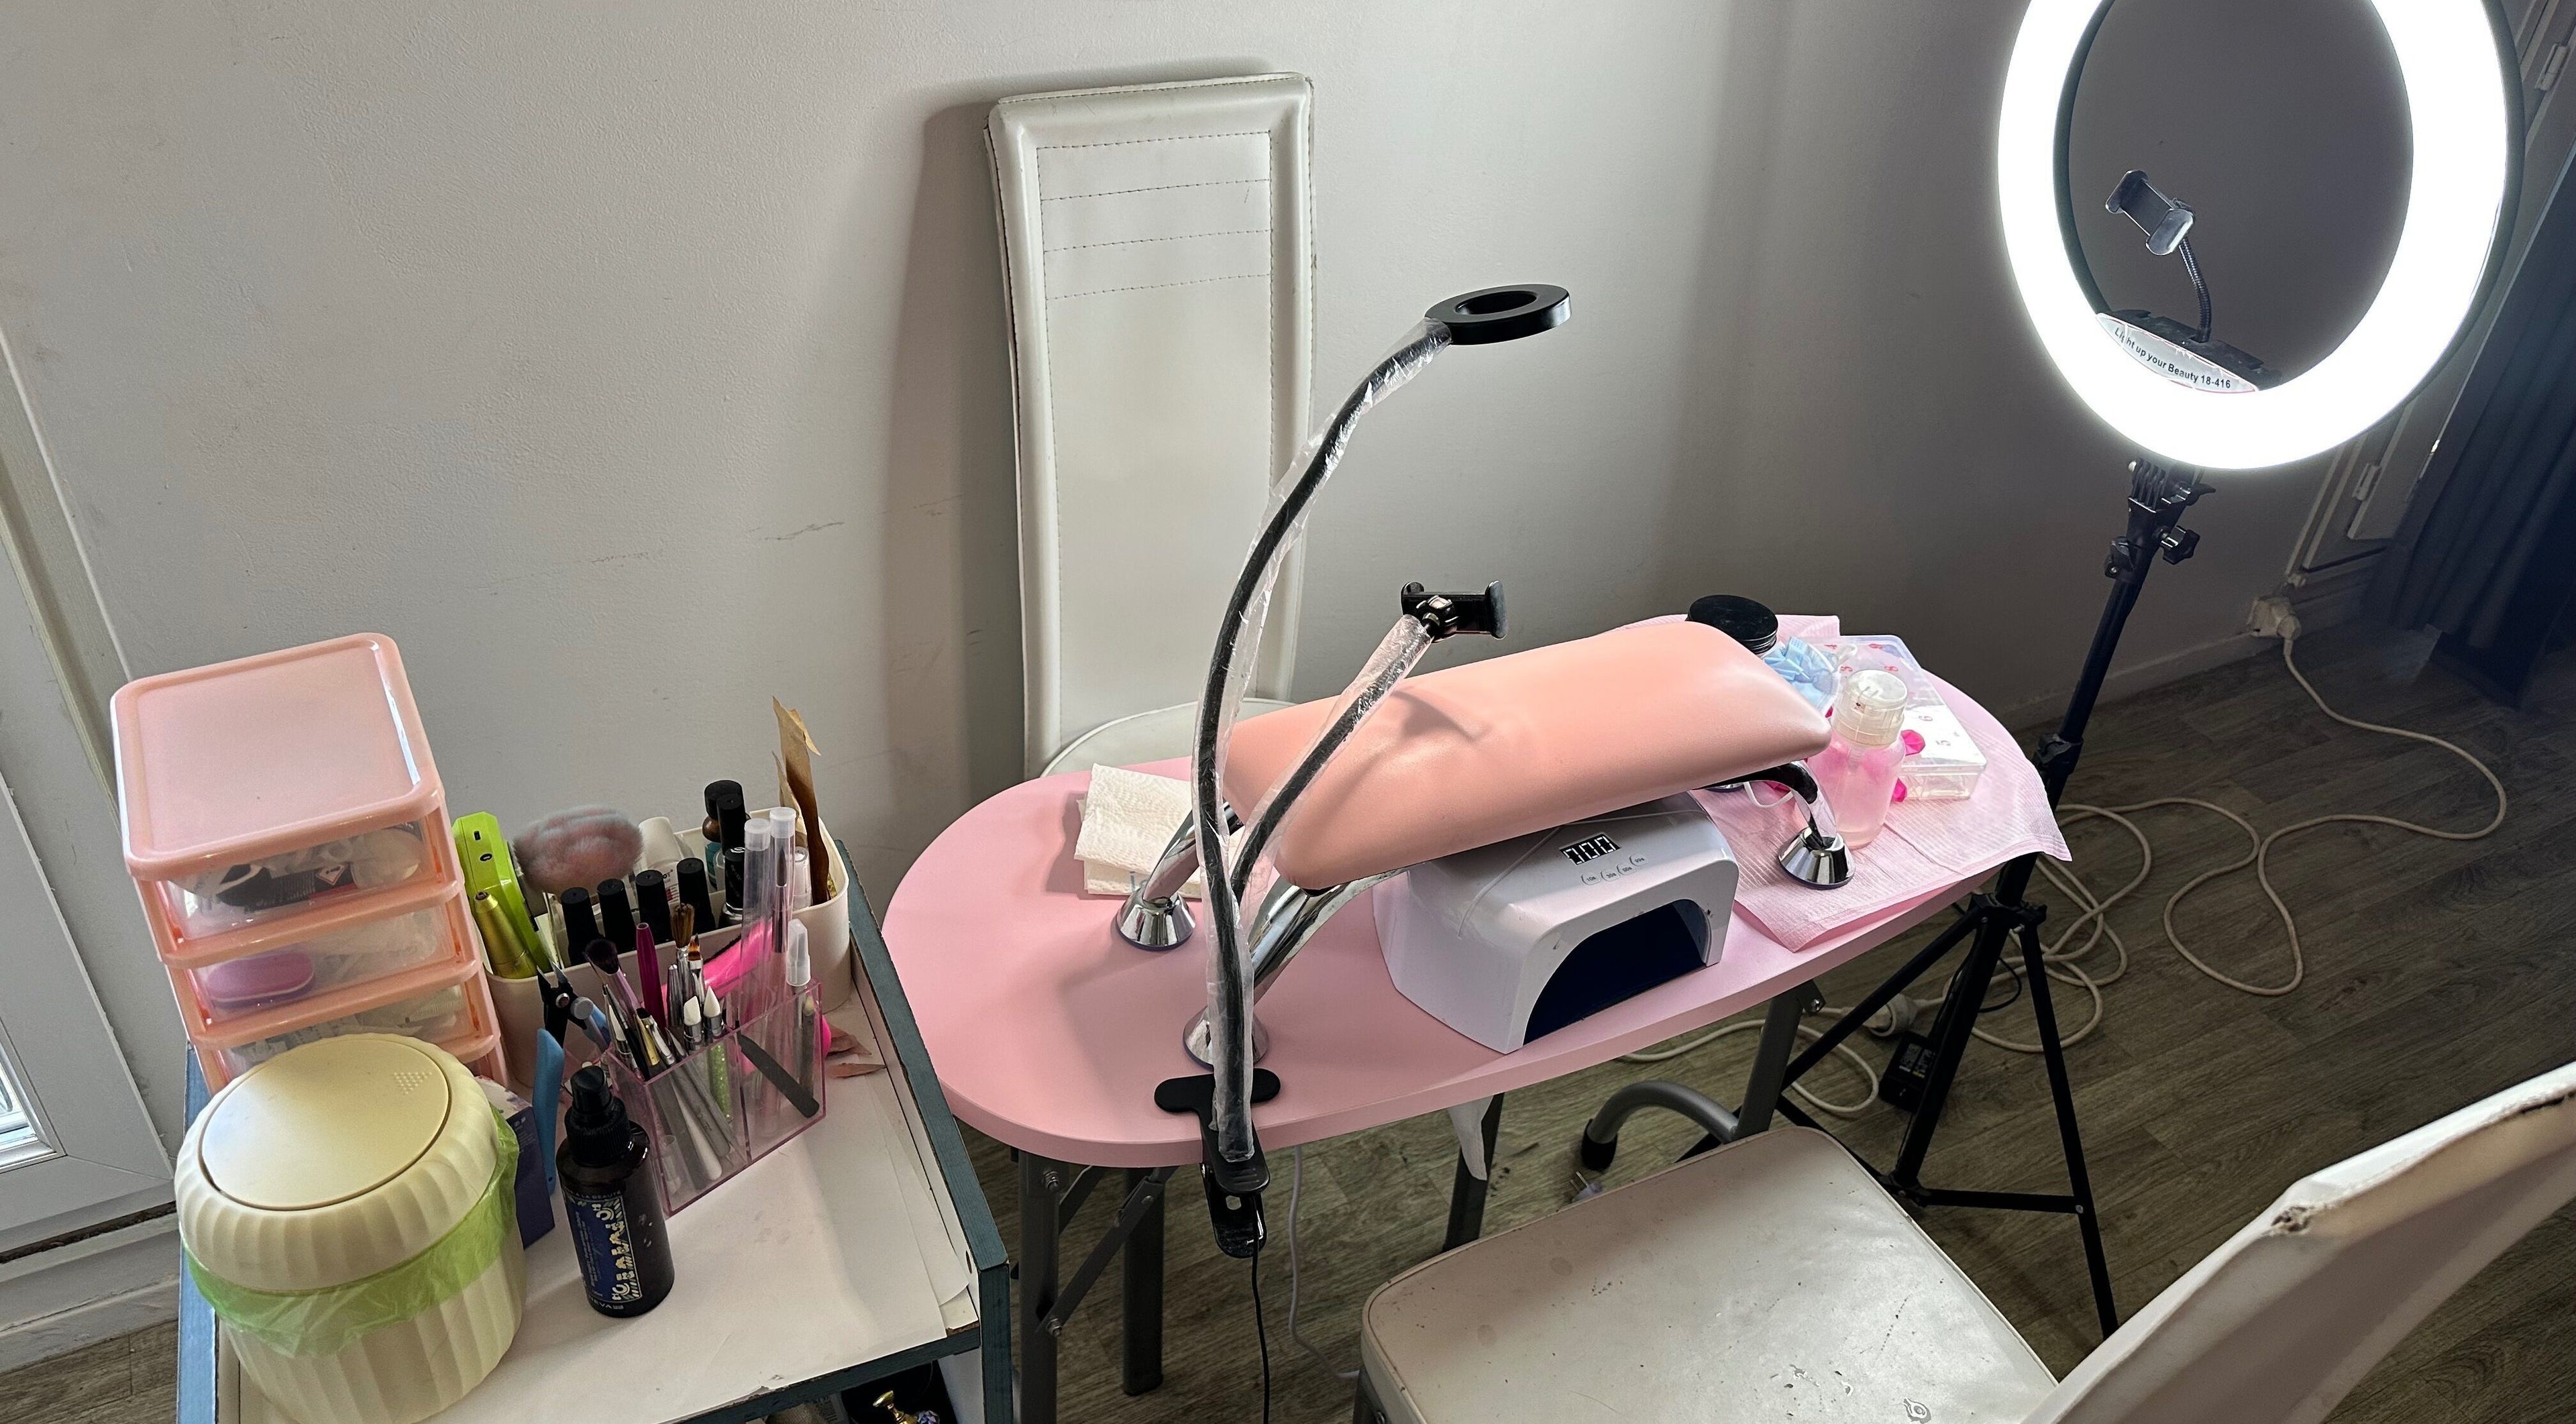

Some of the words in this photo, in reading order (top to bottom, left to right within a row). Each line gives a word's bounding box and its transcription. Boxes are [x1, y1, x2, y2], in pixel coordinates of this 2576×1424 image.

[2136, 344, 2146, 357] up
[2147, 353, 2167, 369] your
[2168, 363, 2199, 383] Beauty
[2200, 375, 2231, 388] 18-416
